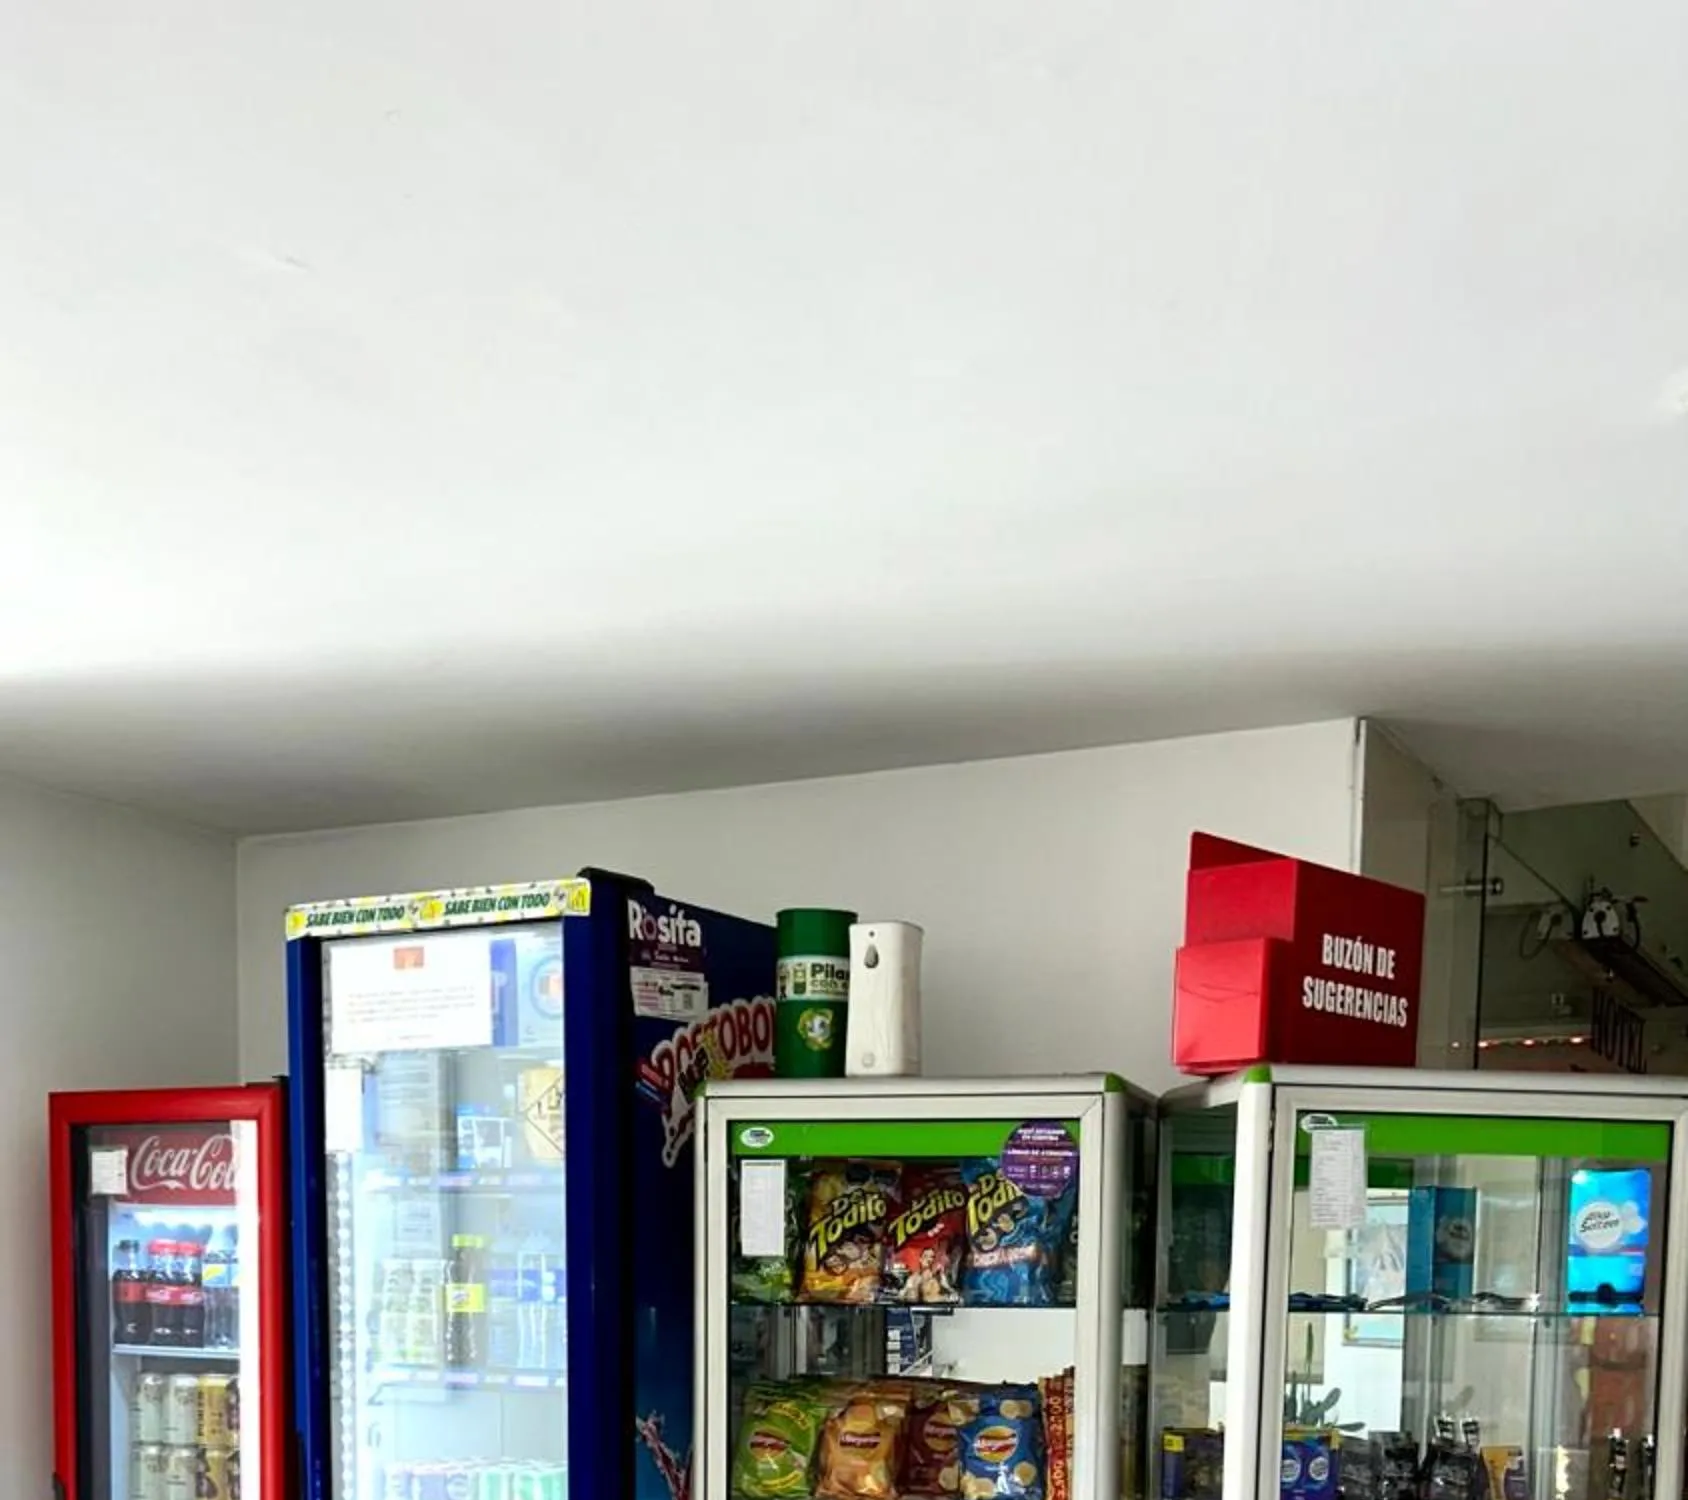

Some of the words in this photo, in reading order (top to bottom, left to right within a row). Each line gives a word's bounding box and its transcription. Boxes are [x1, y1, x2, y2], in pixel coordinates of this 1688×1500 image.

[305, 910, 331, 927] SABE
[332, 909, 355, 925] BIEN
[355, 907, 377, 923] CON
[377, 905, 405, 920] TODO
[445, 900, 470, 916] SABE
[471, 898, 495, 914] BIEN
[497, 896, 519, 912] CON
[520, 893, 550, 909] TODO
[628, 899, 702, 947] Rosita
[811, 962, 850, 980] Pila
[1321, 933, 1374, 975] BUZÓN
[1376, 947, 1396, 979] DE
[1302, 976, 1409, 1027] SUGERENCIAS
[809, 1193, 887, 1258] Todito
[888, 1190, 965, 1246] Todito
